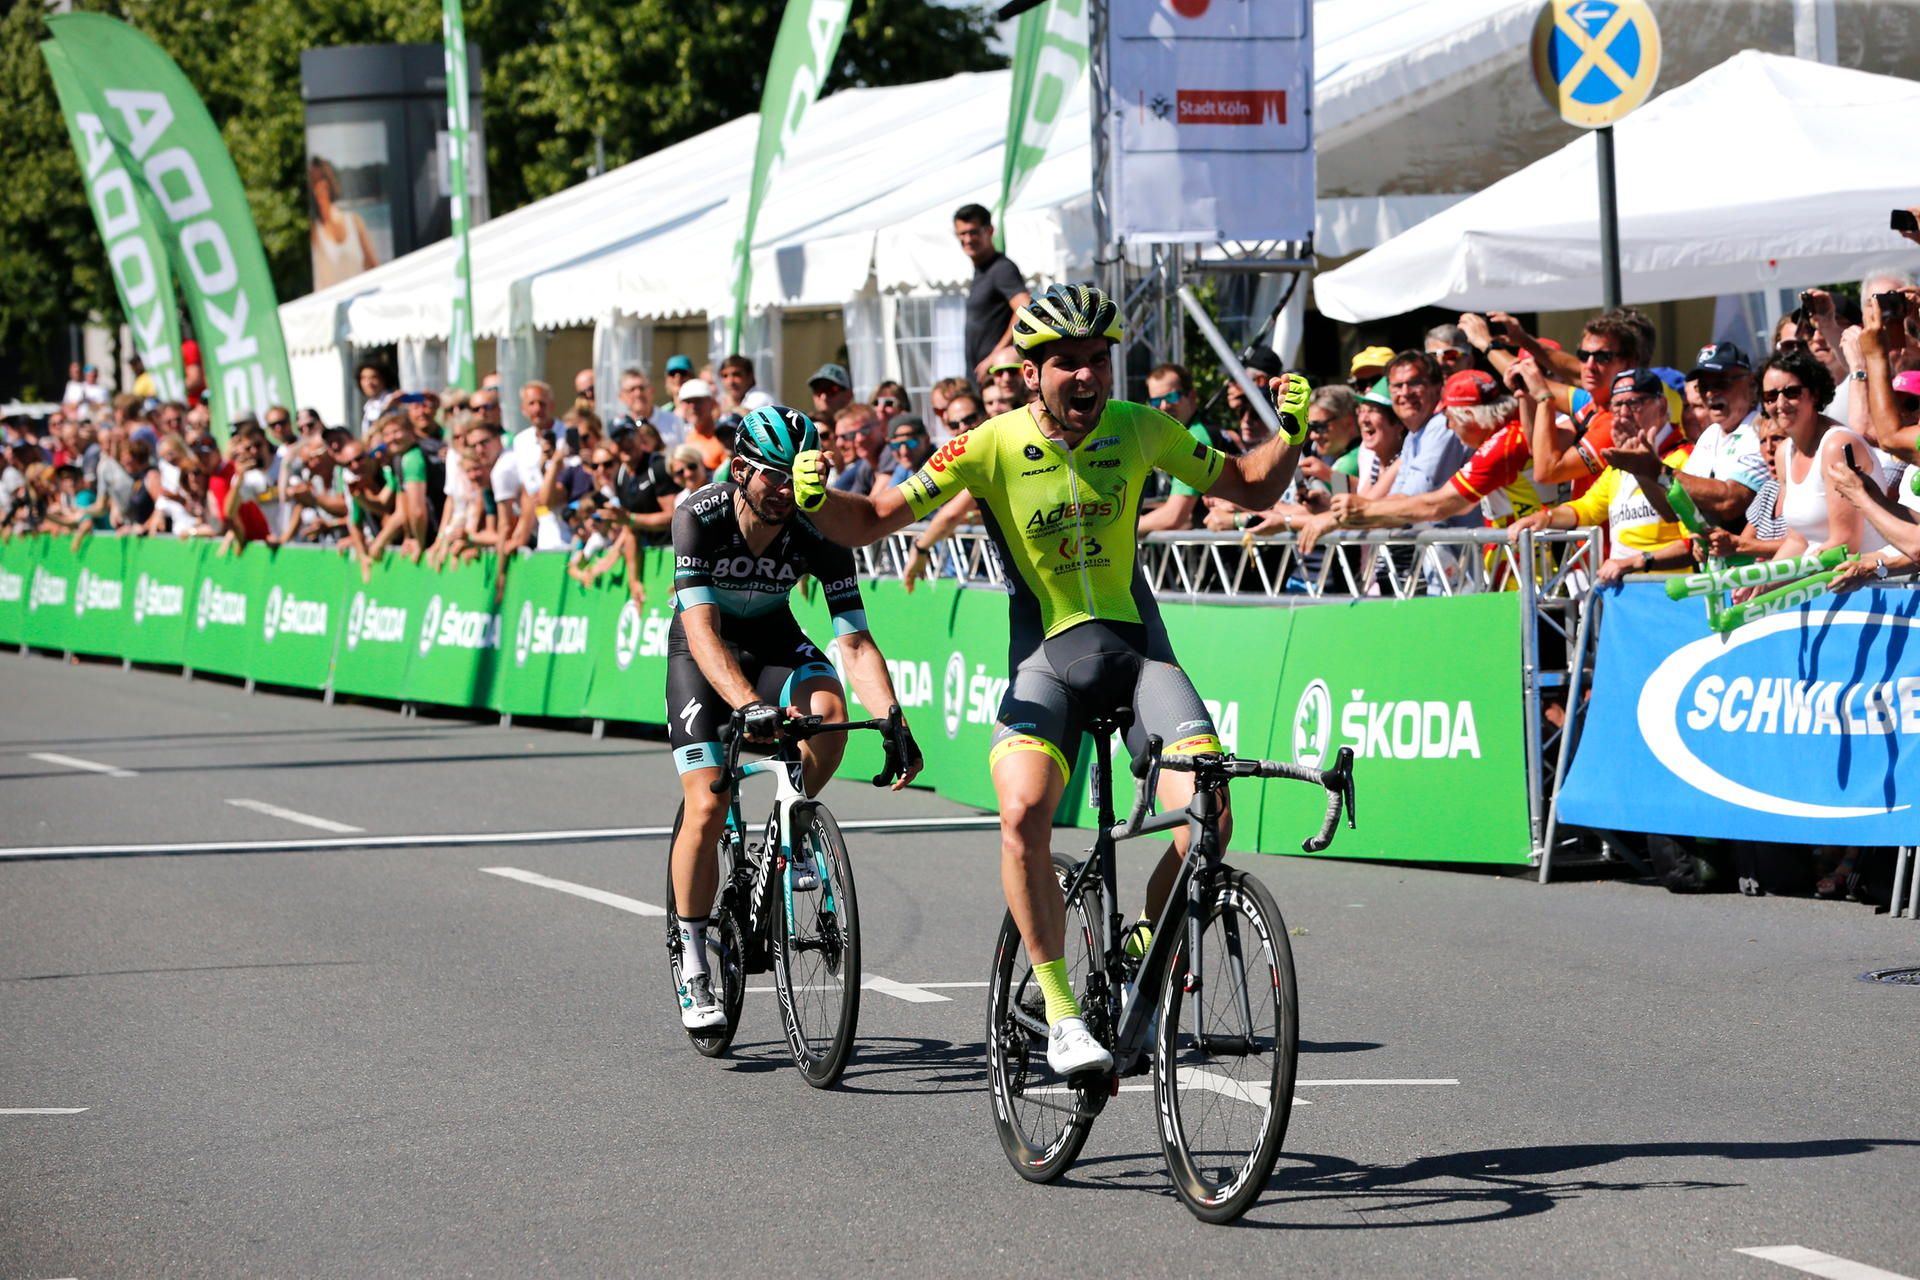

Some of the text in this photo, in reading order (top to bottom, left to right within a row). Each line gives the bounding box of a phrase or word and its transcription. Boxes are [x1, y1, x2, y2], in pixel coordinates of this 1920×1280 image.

[1180, 99, 1250, 115] Stadt Köln
[693, 490, 730, 516] BORA
[1026, 502, 1113, 529] Adeps
[676, 556, 710, 569] BORA
[712, 556, 798, 581] BORA
[437, 602, 502, 649] ŠKODA
[1686, 673, 1920, 735] SCHWALBE
[1340, 688, 1482, 760] ŠKODA
[990, 970, 1010, 1125] SCOPE
[1158, 984, 1178, 1148] SCOPE
